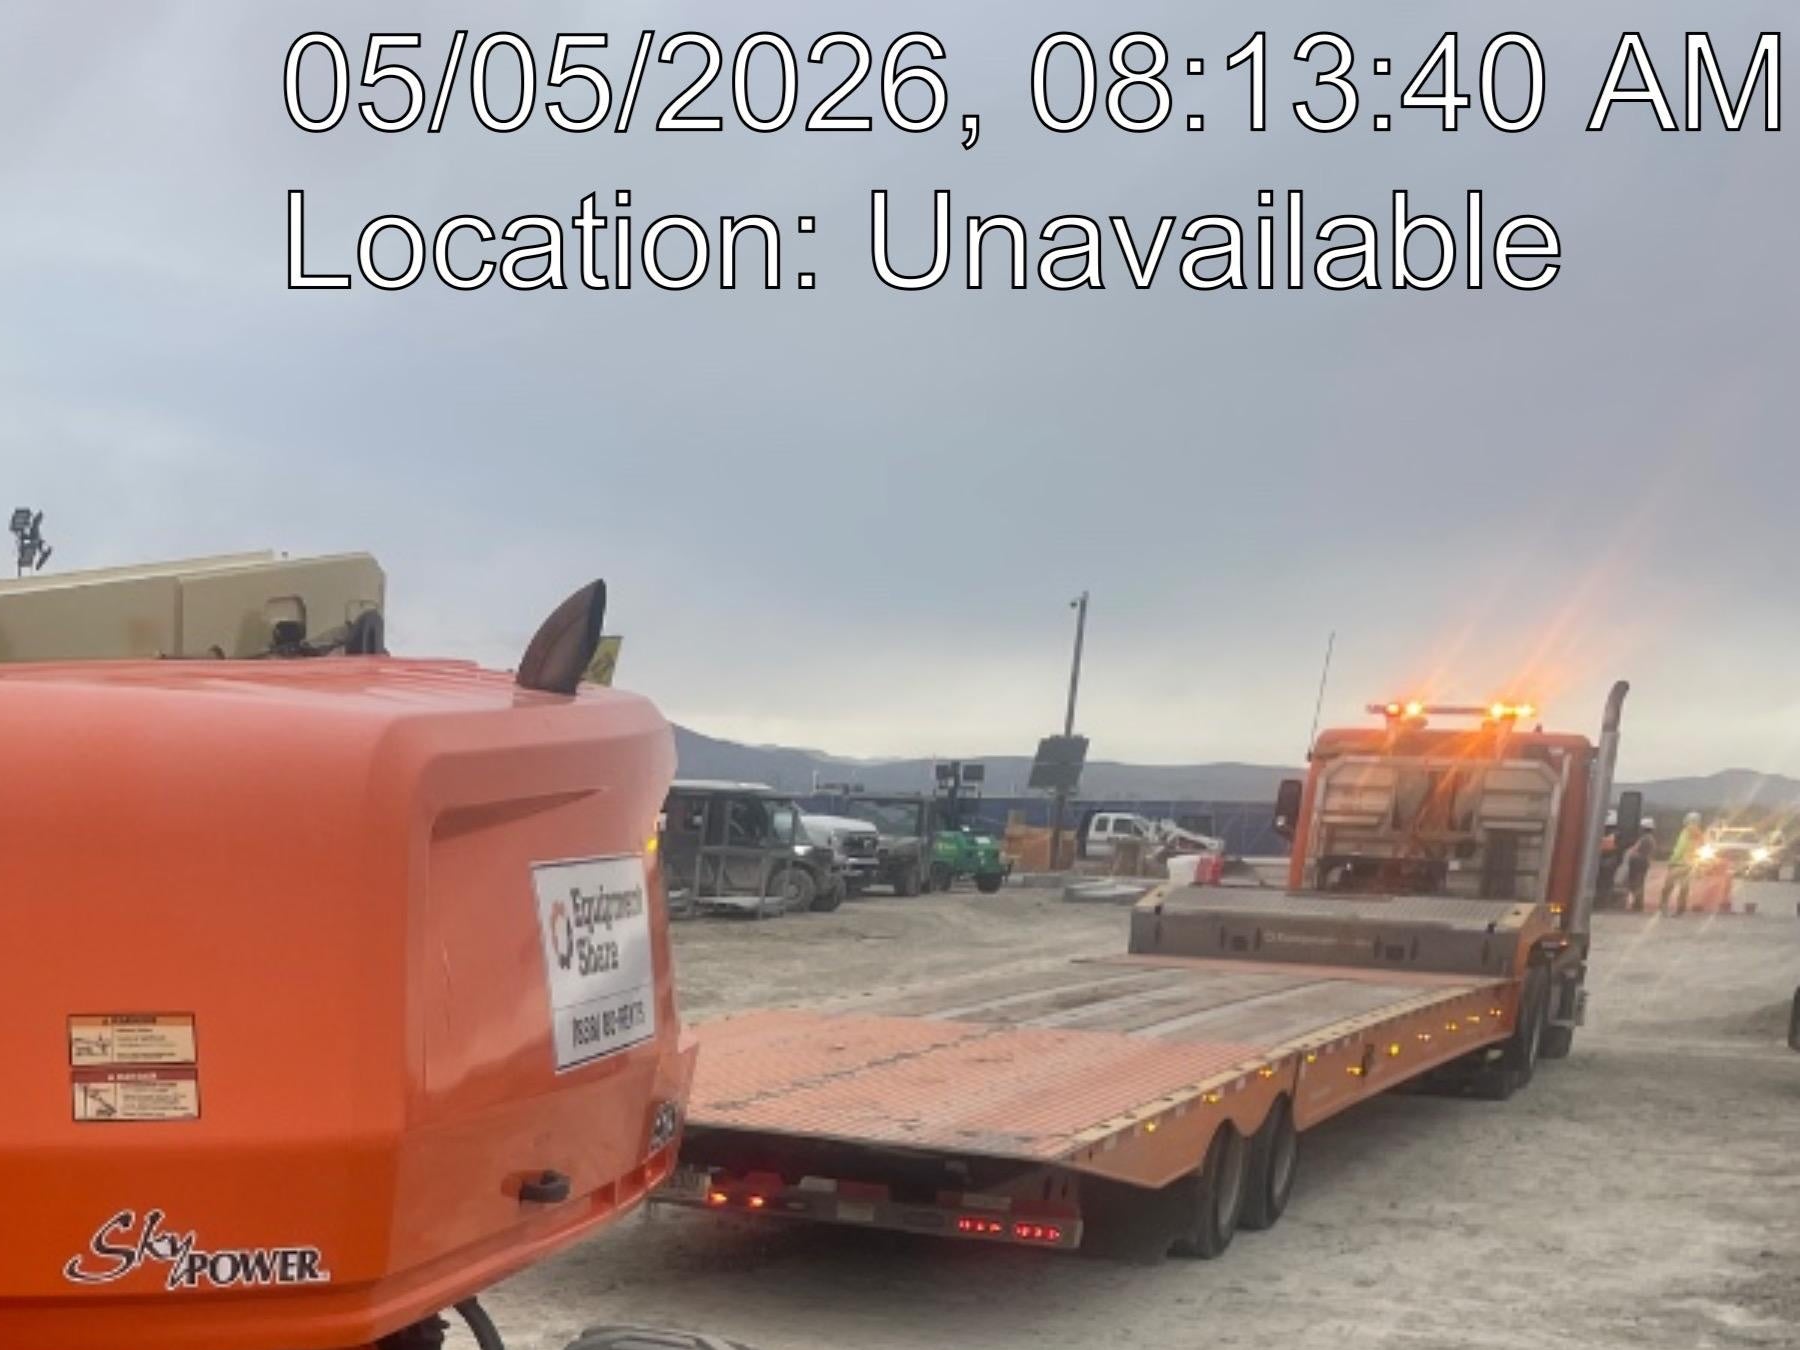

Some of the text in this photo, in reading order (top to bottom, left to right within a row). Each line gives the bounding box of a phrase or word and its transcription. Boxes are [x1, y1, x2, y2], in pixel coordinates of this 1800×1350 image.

[575, 937, 619, 976] Share
[63, 1209, 321, 1290] Sky POWER
